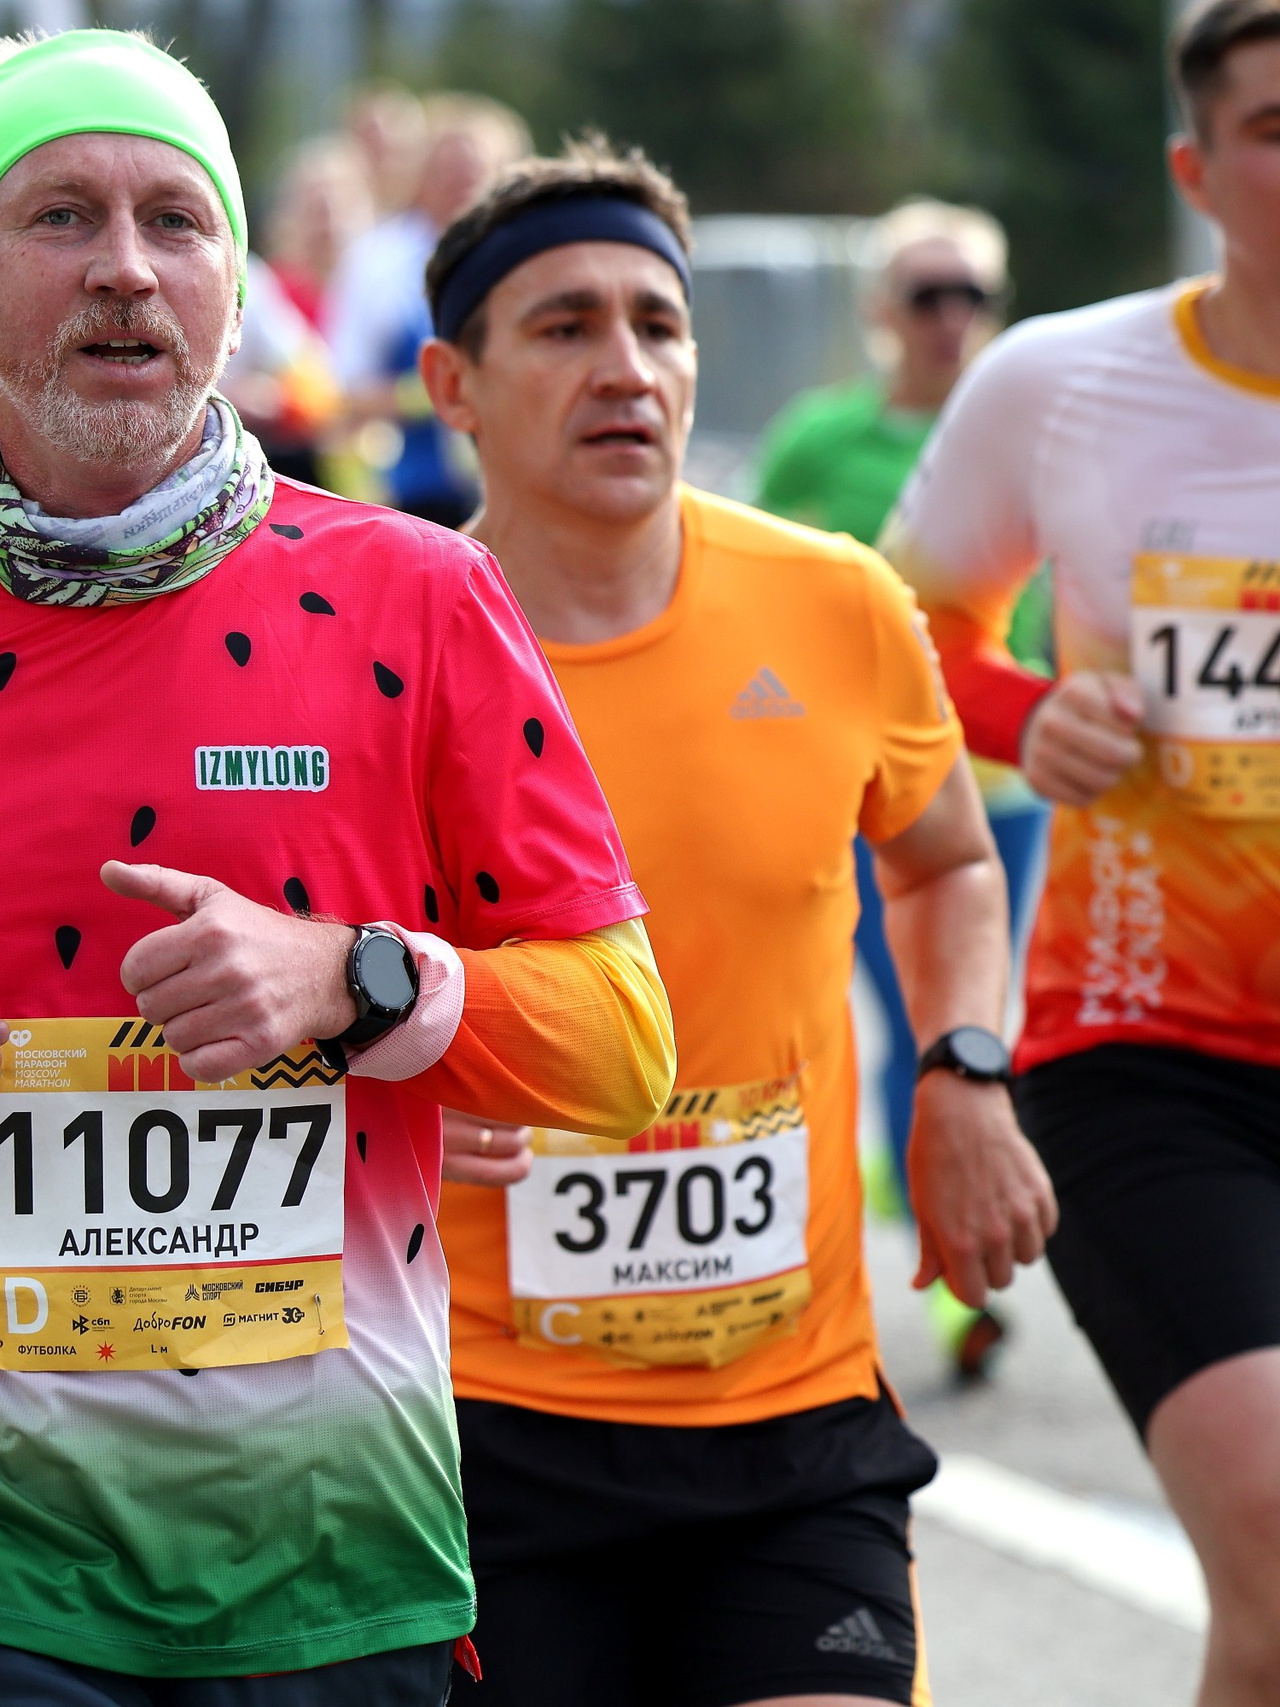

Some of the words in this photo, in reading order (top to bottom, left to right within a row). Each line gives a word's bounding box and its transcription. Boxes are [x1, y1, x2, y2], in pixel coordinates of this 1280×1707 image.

[200, 750, 324, 786] IZMYLONG
[15, 1047, 87, 1058] МОСКОВСКИЙ
[15, 1059, 67, 1068] МАРАФОН
[15, 1069, 61, 1078] MOSCOW
[14, 1078, 71, 1088] MARATHON
[554, 1155, 775, 1255] 3703
[58, 1223, 260, 1258] АЛЕКСАНДР
[613, 1255, 733, 1286] МАКСИМ
[202, 1280, 243, 1291] МОСКОВСКИЙ
[255, 1279, 304, 1293] СИБУР
[202, 1292, 222, 1301] СПОРТ
[4, 1277, 49, 1334] D
[238, 1313, 280, 1323] МАГНИТ
[17, 1345, 77, 1355] ФУТБОЛКА
[151, 1345, 157, 1353] L
